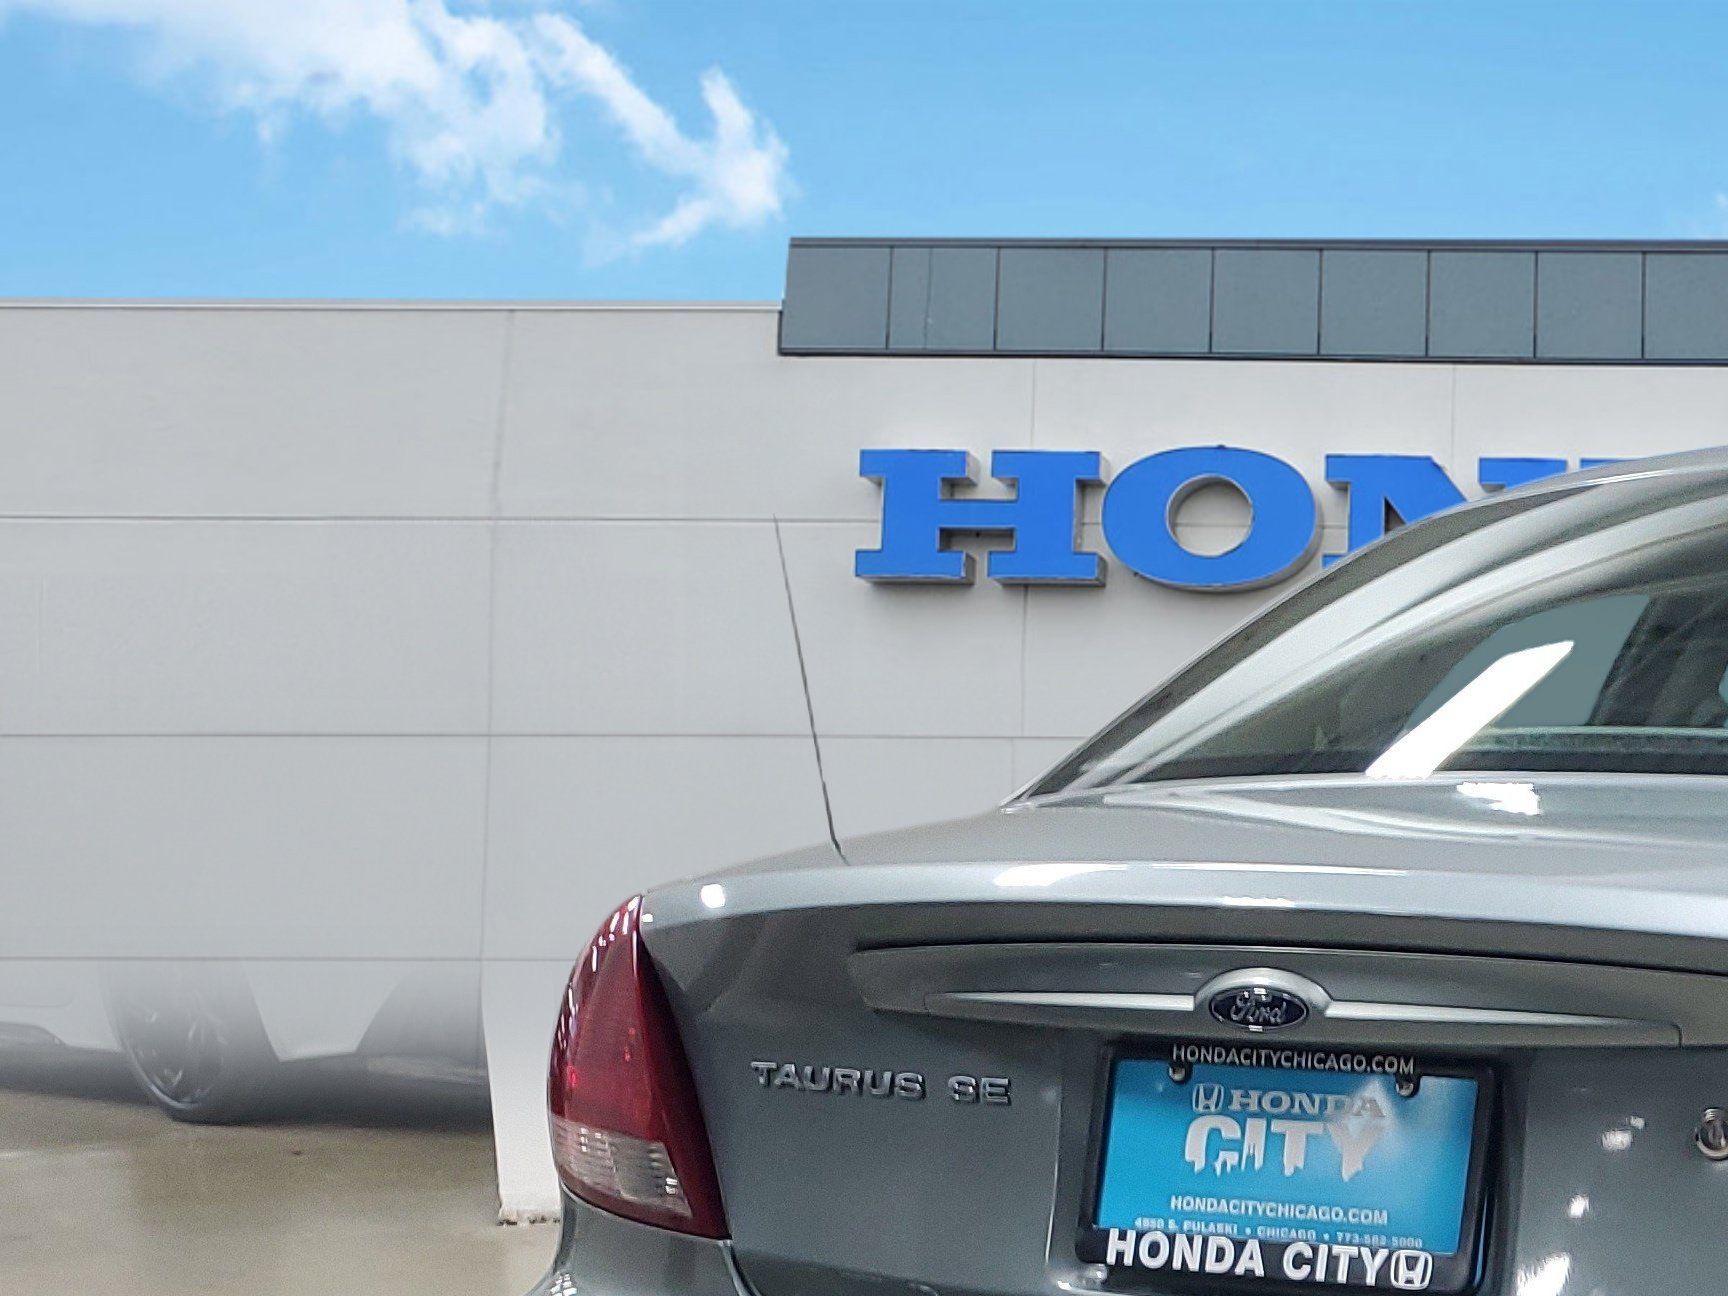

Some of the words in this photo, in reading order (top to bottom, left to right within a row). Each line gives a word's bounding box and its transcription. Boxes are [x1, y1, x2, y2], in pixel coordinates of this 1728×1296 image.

[1172, 1043, 1415, 1075] HONDACITYCHICAGO.COM
[750, 1061, 926, 1101] TAURUS
[947, 1074, 1012, 1104] SE
[1230, 1088, 1386, 1118] HONDA
[1184, 1114, 1387, 1183] CITY
[1170, 1194, 1389, 1226] HONDACITYCHICAGO.COM
[1256, 1225, 1317, 1242] CHICAGO
[1105, 1228, 1265, 1278] HONDA
[1282, 1241, 1392, 1287] CITY
